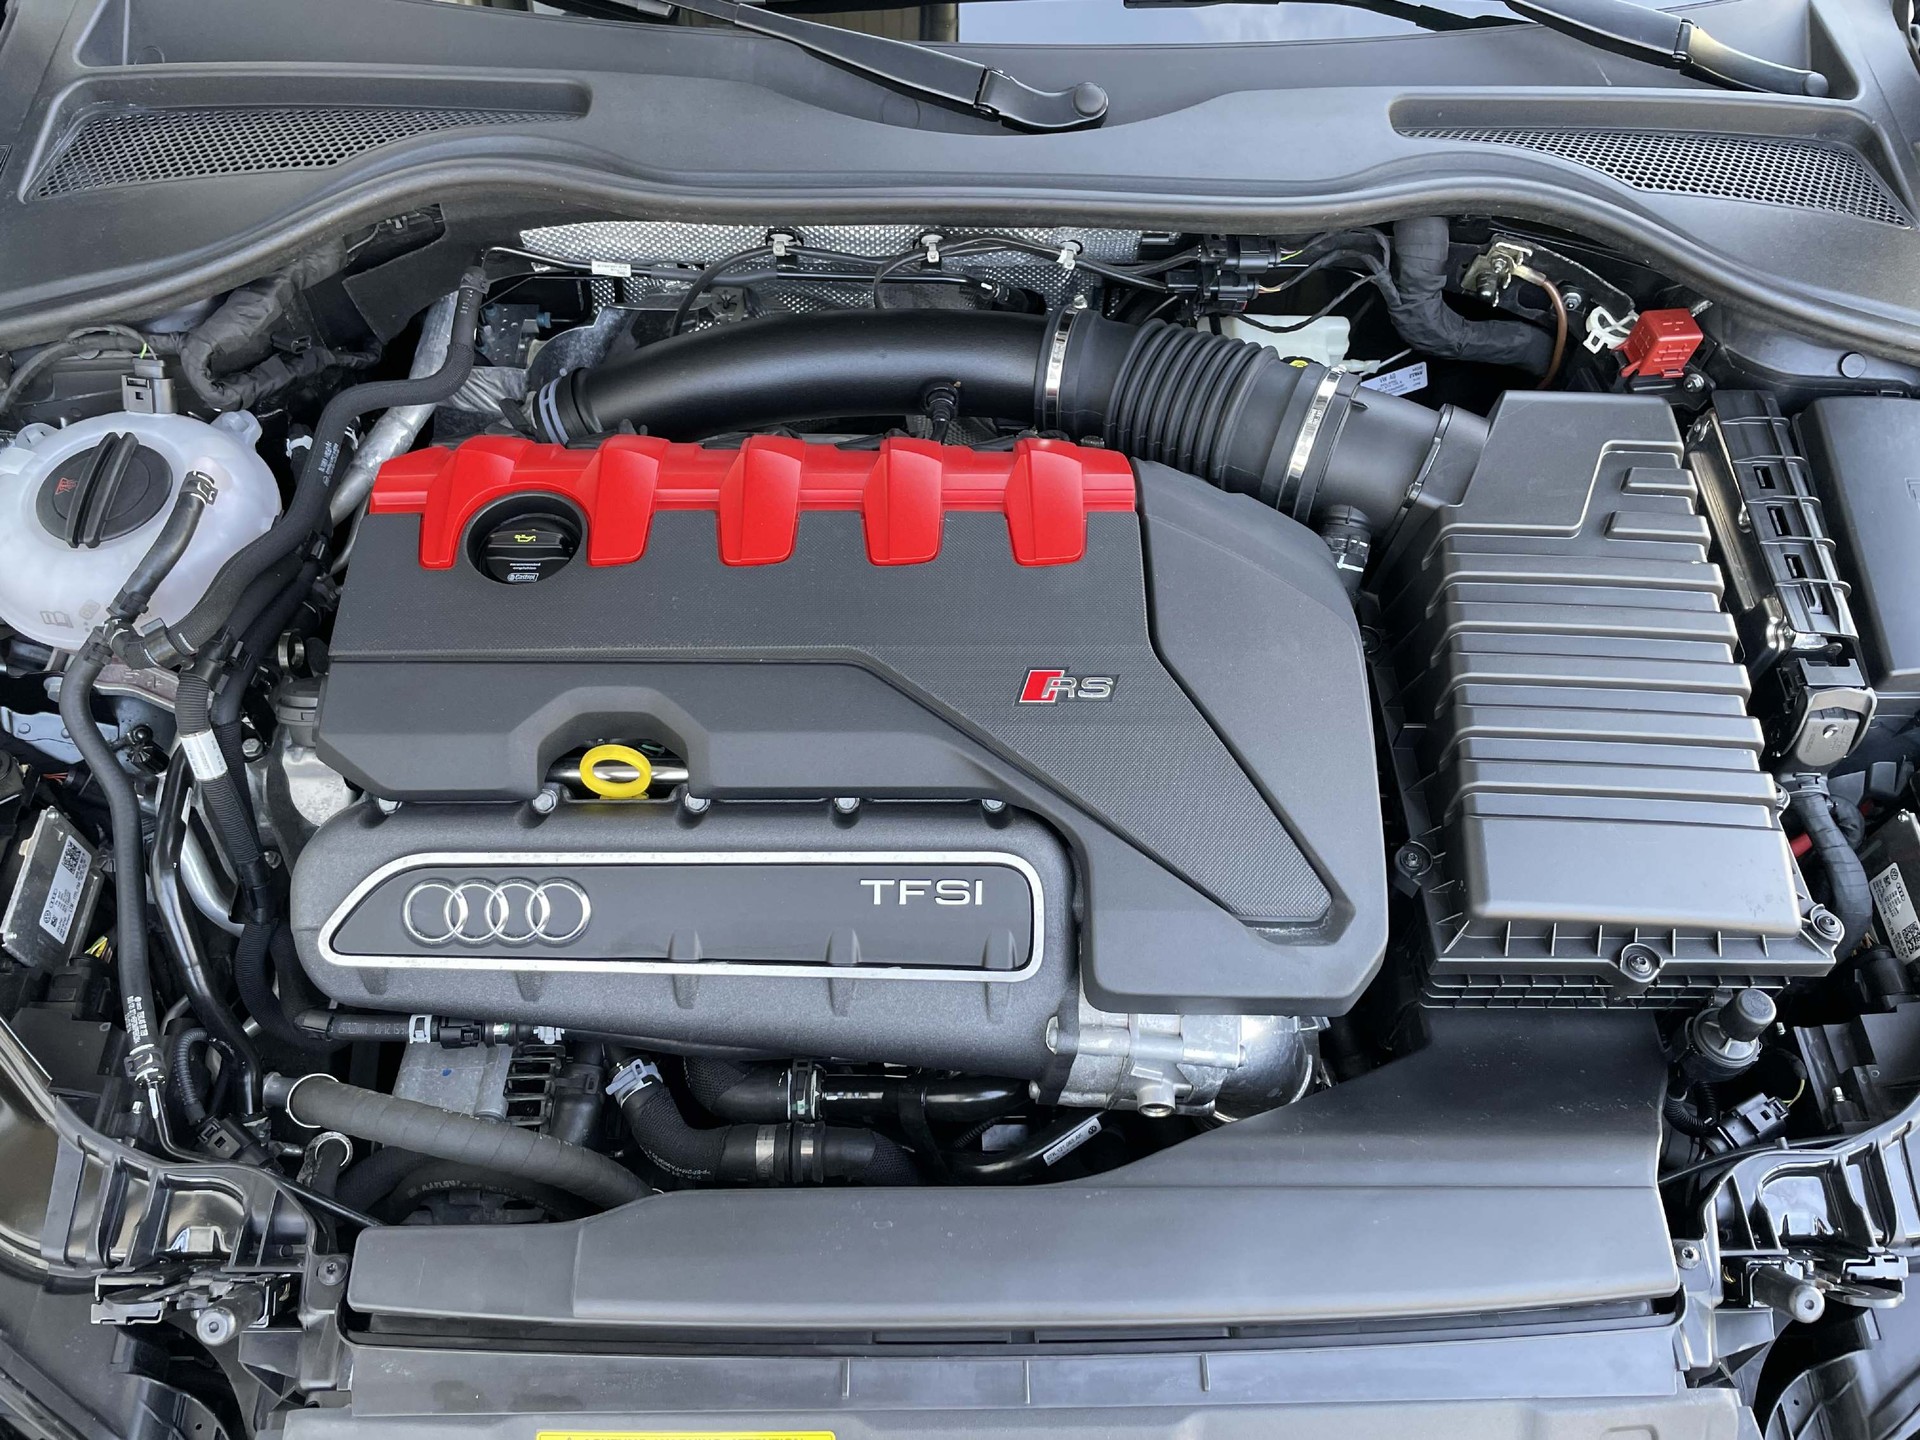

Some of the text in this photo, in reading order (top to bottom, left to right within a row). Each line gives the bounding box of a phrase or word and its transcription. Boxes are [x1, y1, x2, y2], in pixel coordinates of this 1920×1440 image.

[514, 573, 535, 581] Castrol
[1026, 672, 1114, 701] RS
[859, 879, 983, 905] TFSI
